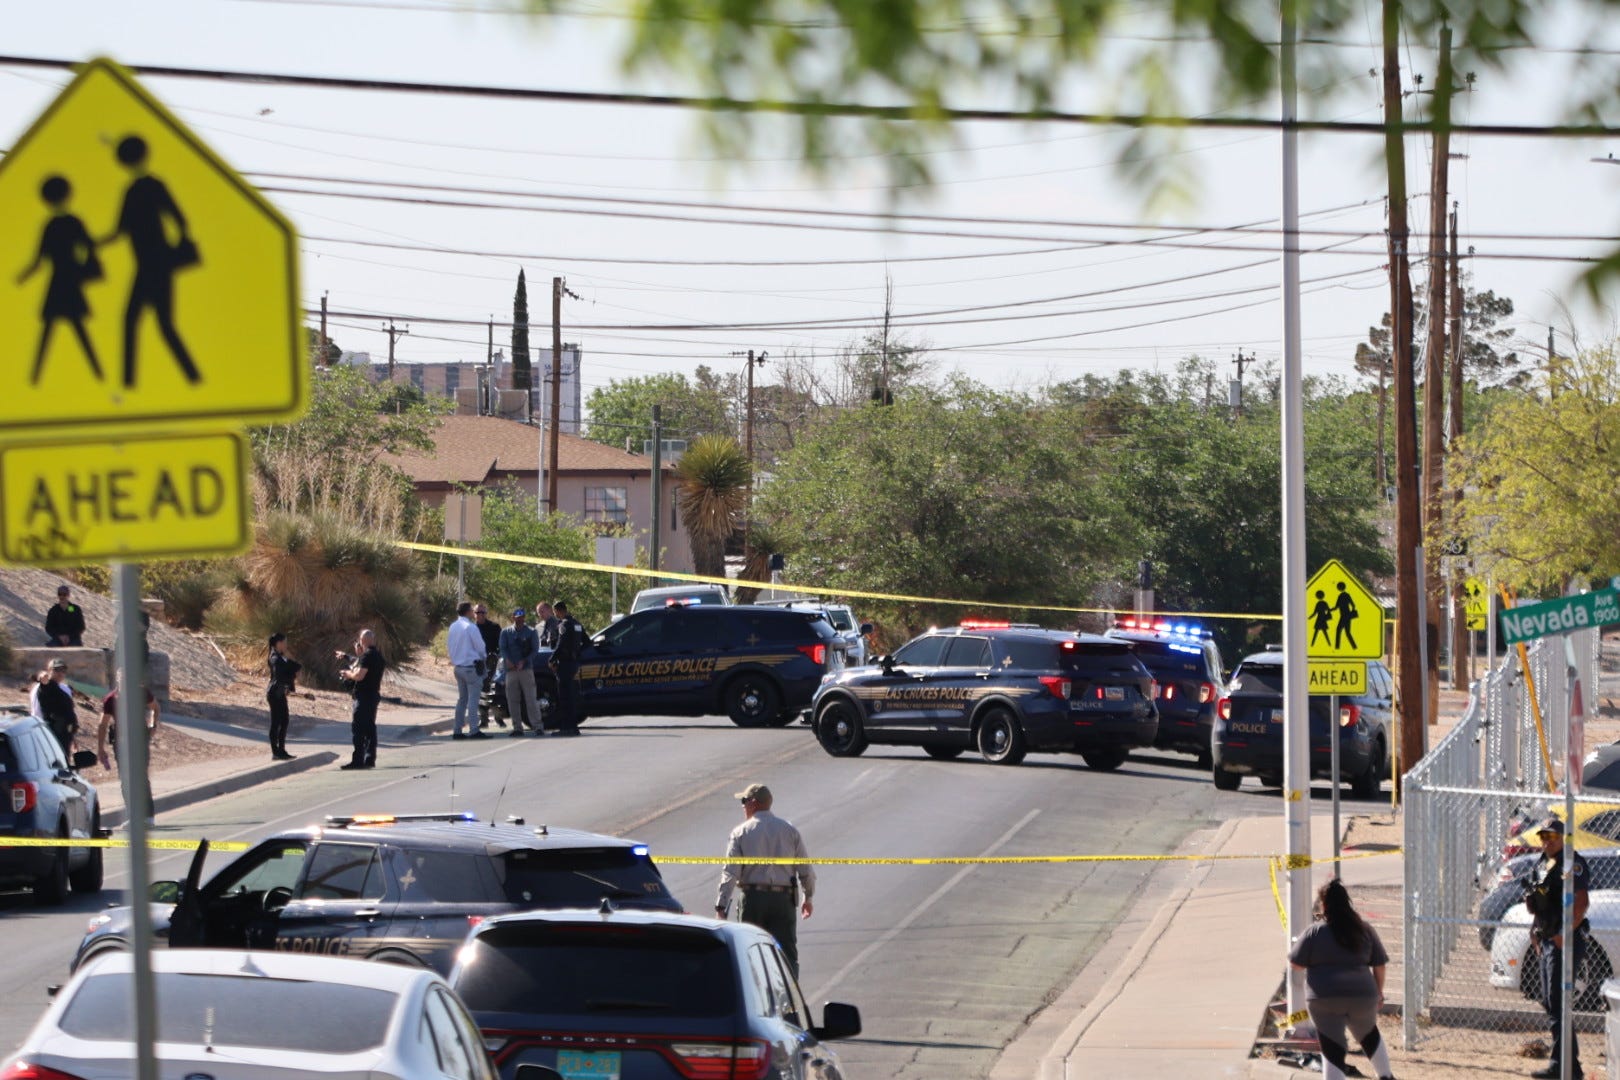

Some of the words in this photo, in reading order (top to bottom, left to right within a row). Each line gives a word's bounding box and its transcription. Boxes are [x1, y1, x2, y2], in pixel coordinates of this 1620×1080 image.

[26, 465, 225, 529] AHEAD
[1502, 602, 1589, 640] Nevada
[1594, 595, 1613, 608] Ave
[1593, 607, 1619, 623] 1900
[600, 663, 624, 678] LAS
[625, 660, 671, 677] CRUCES
[672, 657, 715, 673] POLICE
[1309, 670, 1358, 686] AHEAD
[885, 687, 903, 699] LAS
[903, 687, 939, 699] CRUCES
[940, 687, 974, 700] POLICE
[1232, 722, 1267, 733] POLICE
[293, 937, 349, 955] POLICE
[541, 1035, 637, 1044] DODGE
